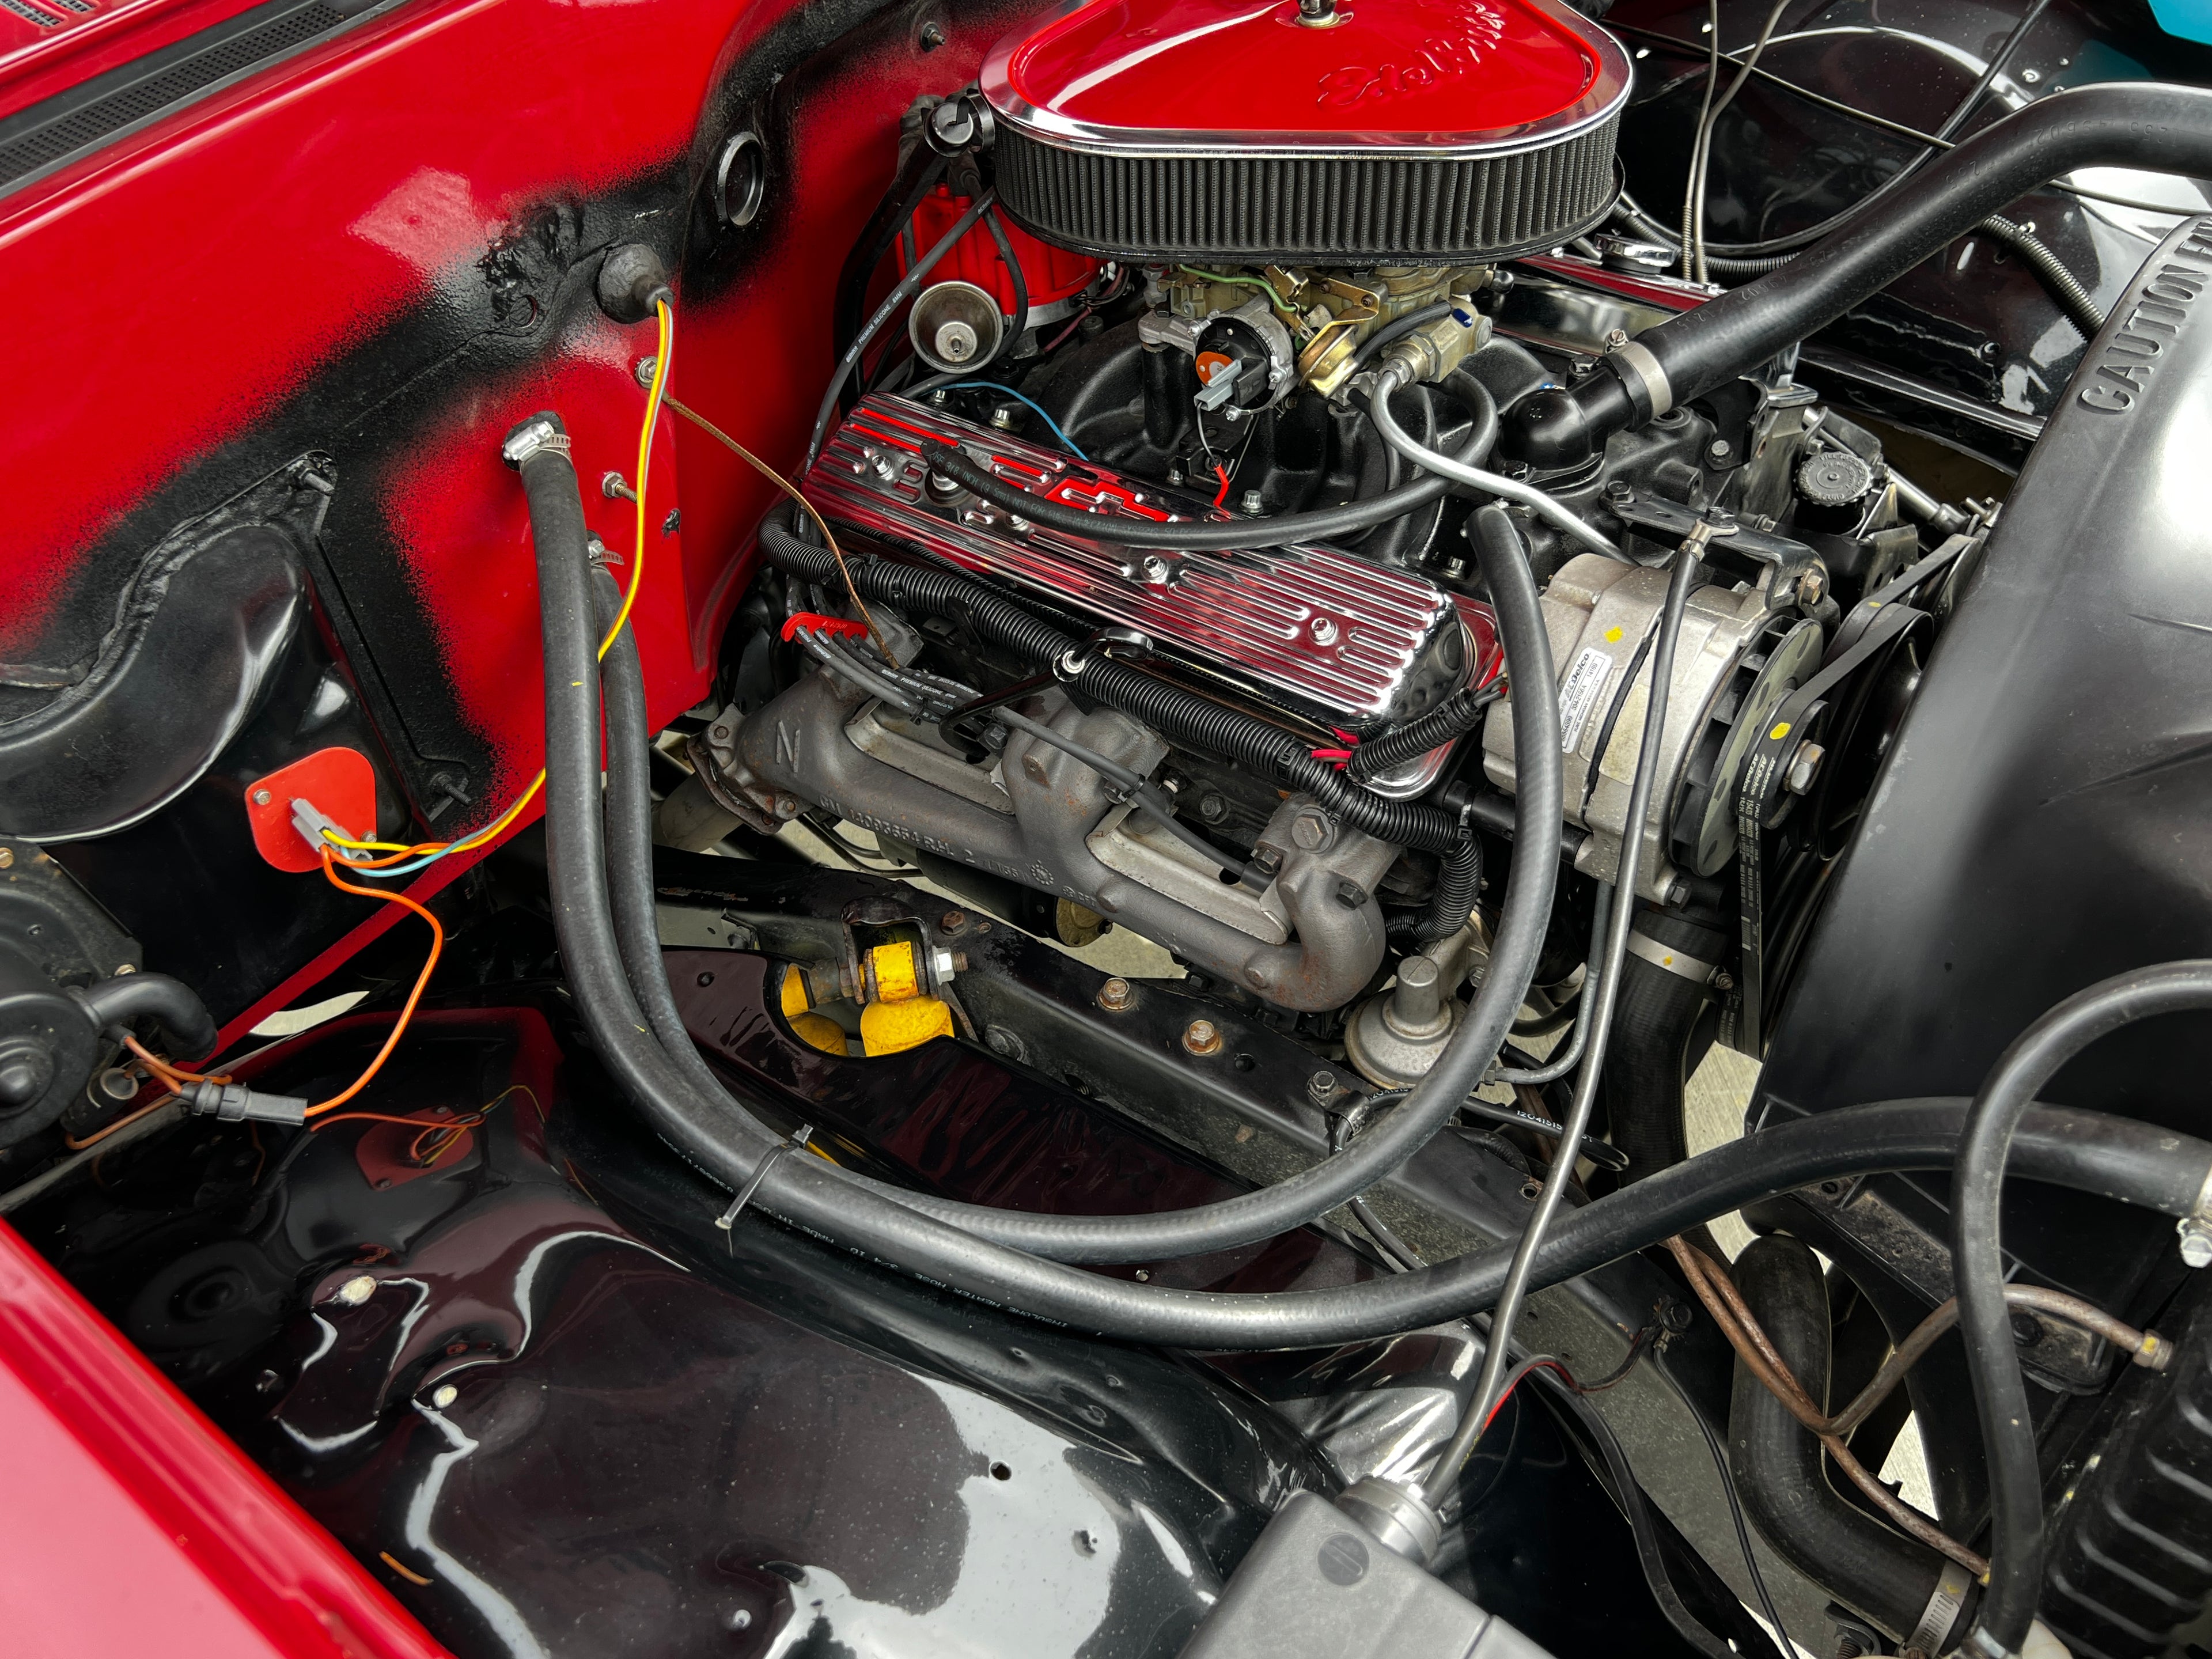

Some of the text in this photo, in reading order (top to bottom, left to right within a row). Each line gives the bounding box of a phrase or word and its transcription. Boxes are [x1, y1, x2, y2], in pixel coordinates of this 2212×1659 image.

[858, 323, 874, 344] PREMIUM
[873, 304, 892, 325] SILICONE
[2080, 263, 2209, 412] CAUTION
[962, 470, 979, 487] INCH
[1012, 498, 1028, 509] NOT
[1030, 503, 1046, 514] FOR
[1751, 753, 1767, 796] ACDelco
[802, 1225, 835, 1244] MADE
[914, 1272, 946, 1289] HOSE
[953, 1287, 1002, 1308] HEATER
